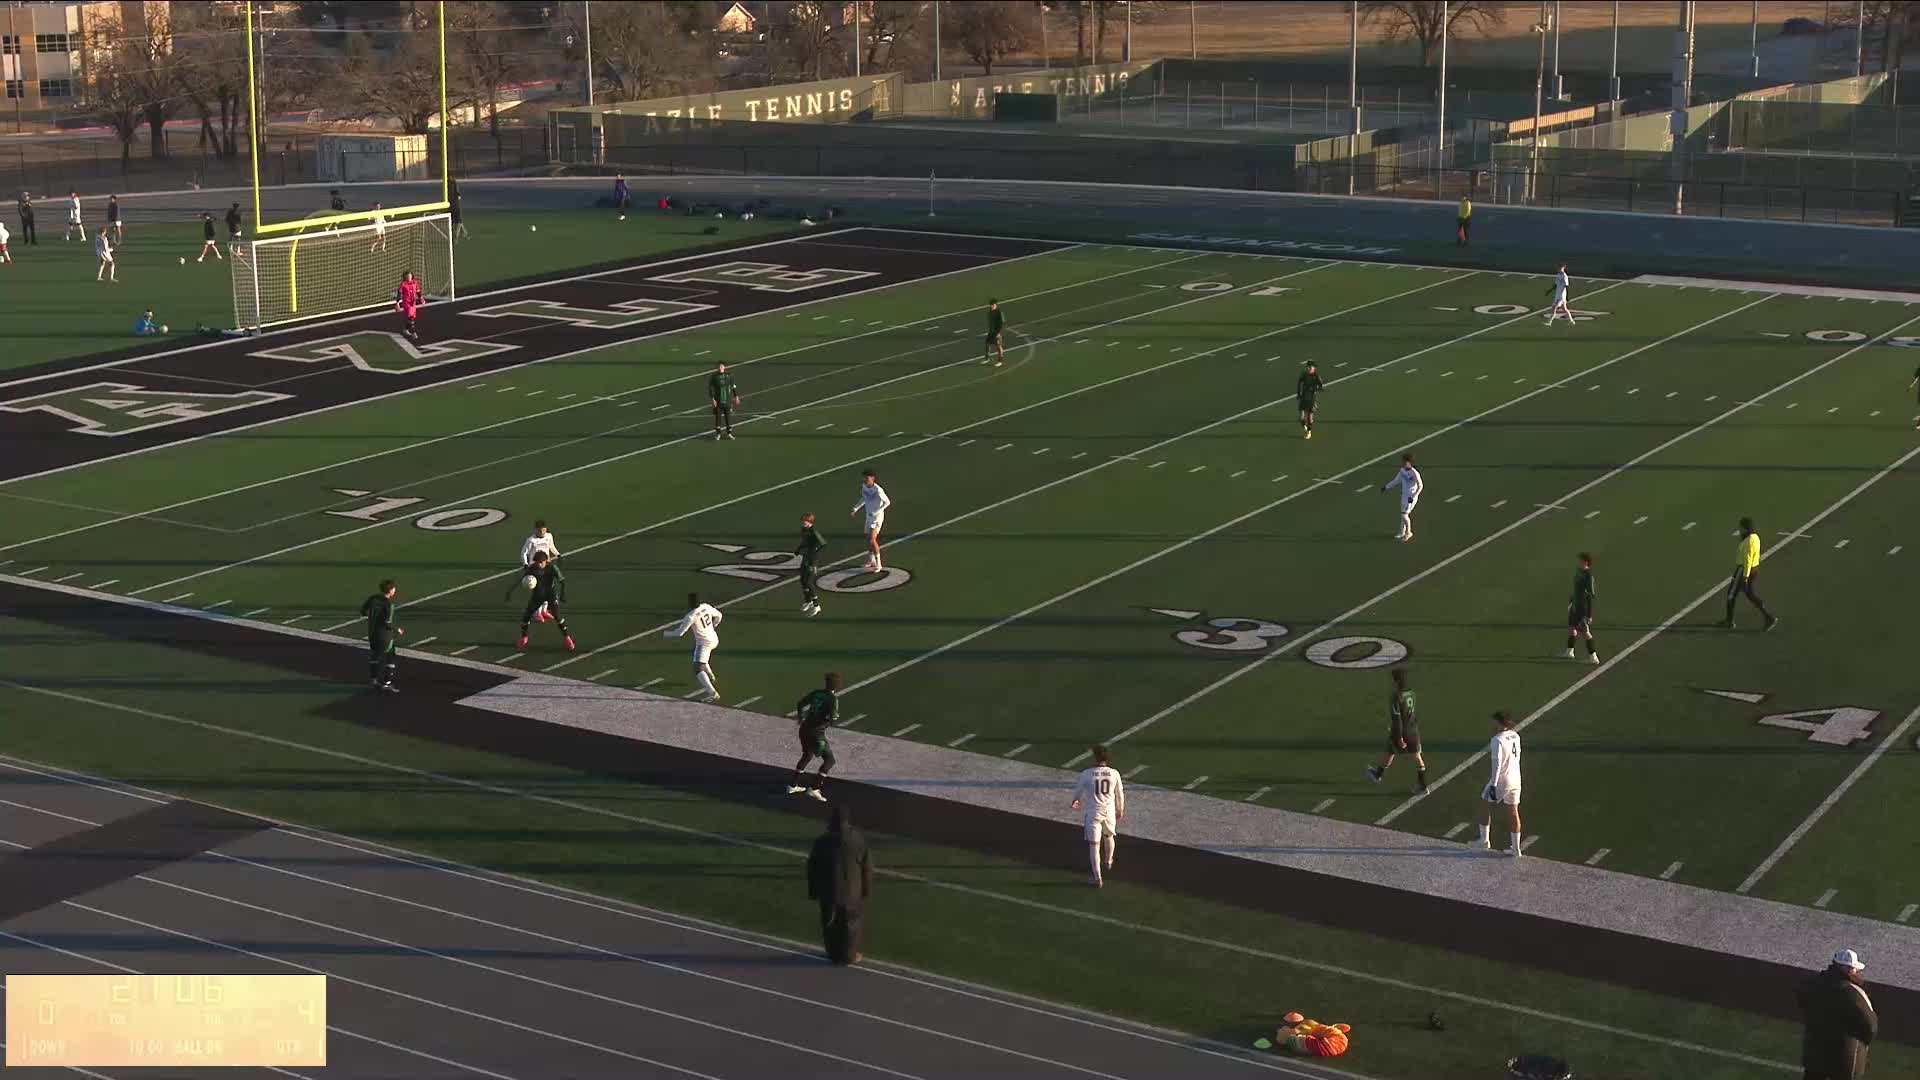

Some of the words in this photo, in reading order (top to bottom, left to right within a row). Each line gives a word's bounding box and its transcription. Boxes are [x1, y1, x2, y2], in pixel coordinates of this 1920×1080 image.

[746, 89, 853, 121] TENNIS
[325, 497, 507, 531] 10
[700, 551, 912, 593] 20
[700, 613, 711, 629] 12
[1175, 617, 1409, 669] 30
[1511, 742, 1517, 757] 4
[1095, 779, 1110, 795] 10
